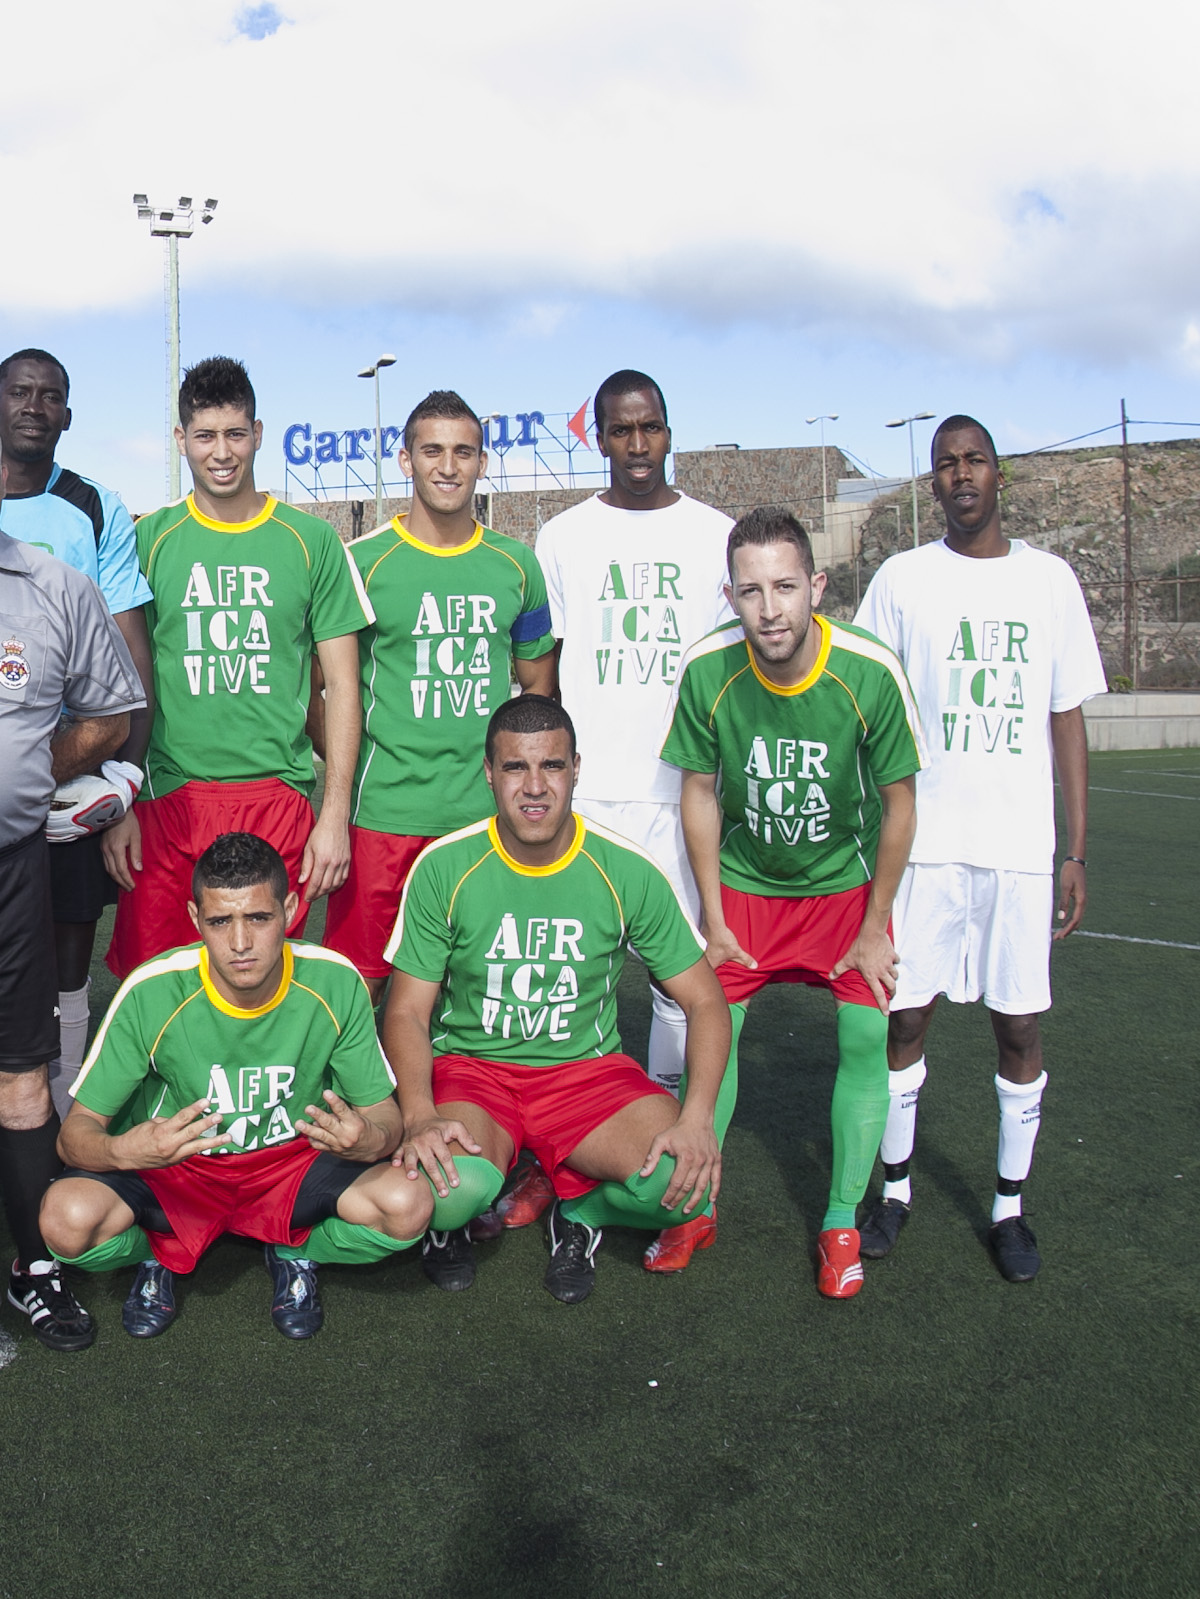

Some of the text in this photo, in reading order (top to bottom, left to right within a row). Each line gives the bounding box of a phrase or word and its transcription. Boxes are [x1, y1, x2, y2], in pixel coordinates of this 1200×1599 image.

[283, 410, 544, 466] Carrur
[180, 562, 274, 607] ÁFR
[598, 560, 684, 601] ÁFR
[182, 610, 271, 651] ICA
[411, 592, 498, 635] ÁFR
[601, 605, 681, 644] ICA
[412, 637, 491, 676] ICA
[946, 616, 1029, 663] ÁFR
[944, 667, 1024, 710] ICA
[743, 736, 831, 779] ÁFR
[744, 775, 831, 816] ICA
[484, 912, 586, 961] ÁFR
[484, 963, 579, 1003] ICA
[203, 1064, 296, 1114] ÁFR
